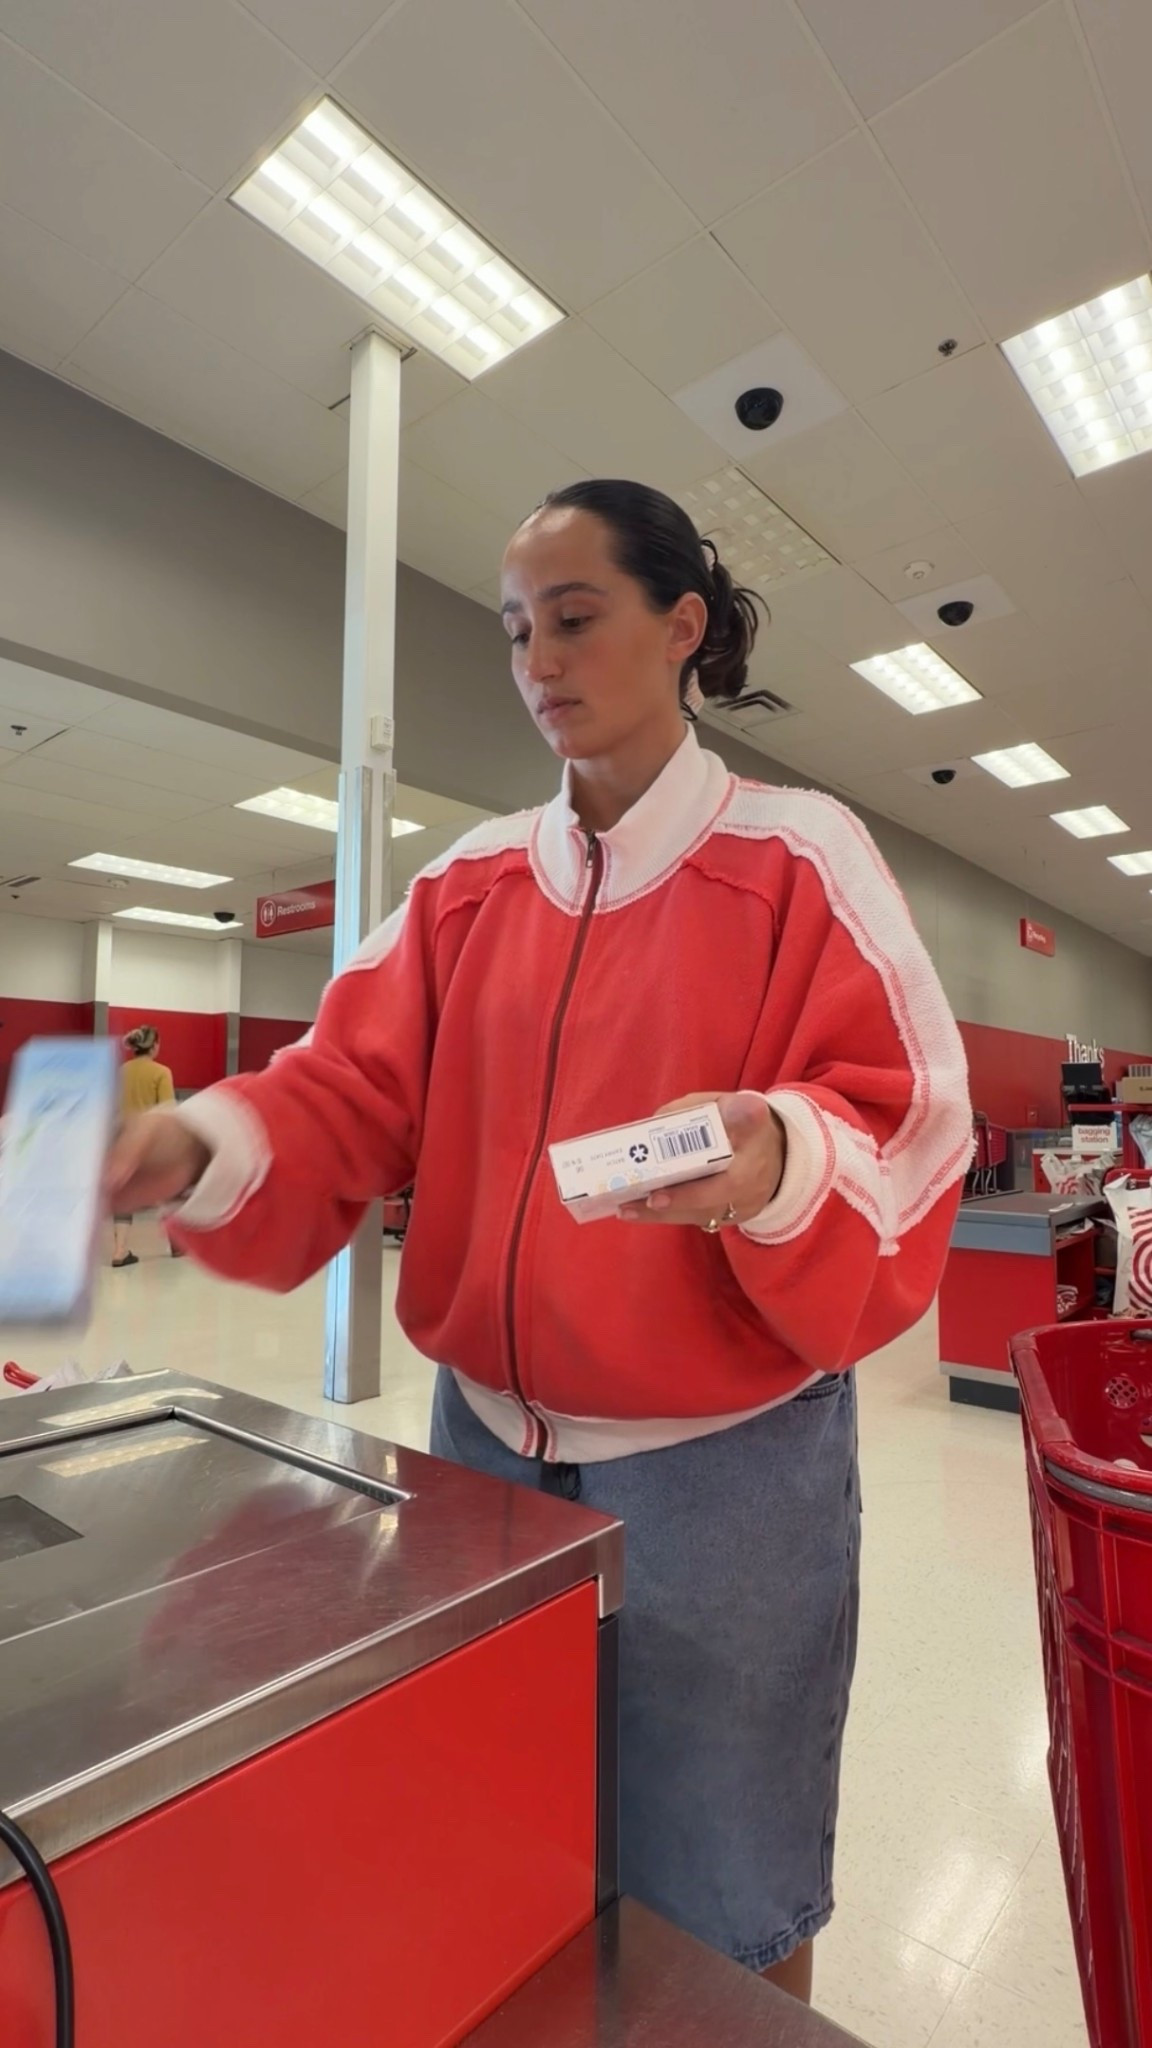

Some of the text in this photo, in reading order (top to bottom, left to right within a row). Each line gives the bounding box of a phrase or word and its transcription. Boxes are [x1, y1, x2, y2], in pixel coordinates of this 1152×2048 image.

[277, 901, 316, 917] Restrooms
[1065, 1033, 1105, 1069] Thanks
[1078, 1127, 1111, 1137] bagging
[1081, 1136, 1109, 1144] station
